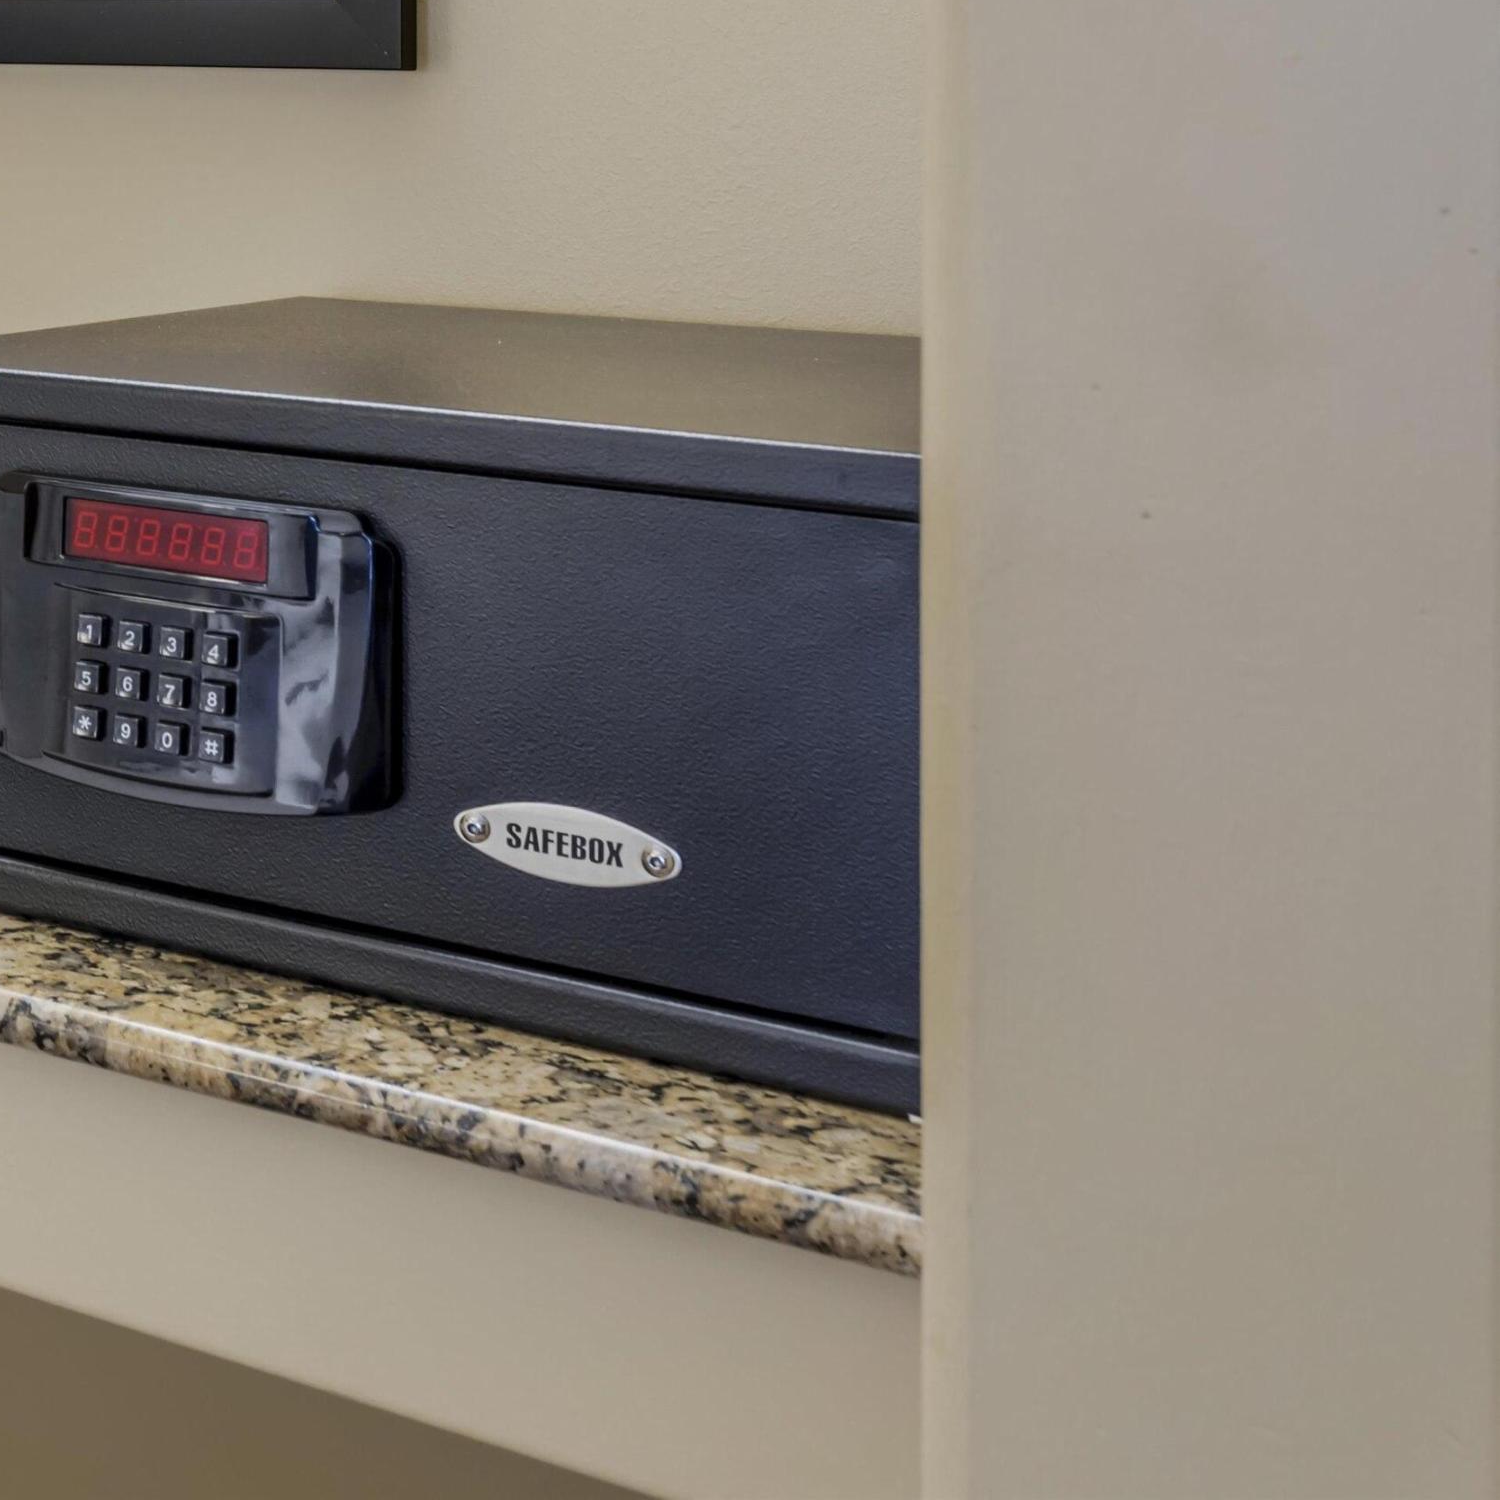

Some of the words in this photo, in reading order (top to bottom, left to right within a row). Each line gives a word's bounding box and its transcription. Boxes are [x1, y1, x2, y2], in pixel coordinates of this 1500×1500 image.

[86, 624, 93, 640] 1
[124, 630, 135, 646] 2
[166, 637, 177, 653] 3
[208, 644, 219, 660] 4
[81, 671, 92, 686] 5
[122, 676, 133, 692] 6
[164, 684, 176, 701] 7
[206, 691, 218, 707] 8
[120, 723, 131, 739] 9
[161, 731, 173, 748] 0
[204, 739, 219, 756] #
[506, 822, 624, 868] SAFEBOX
